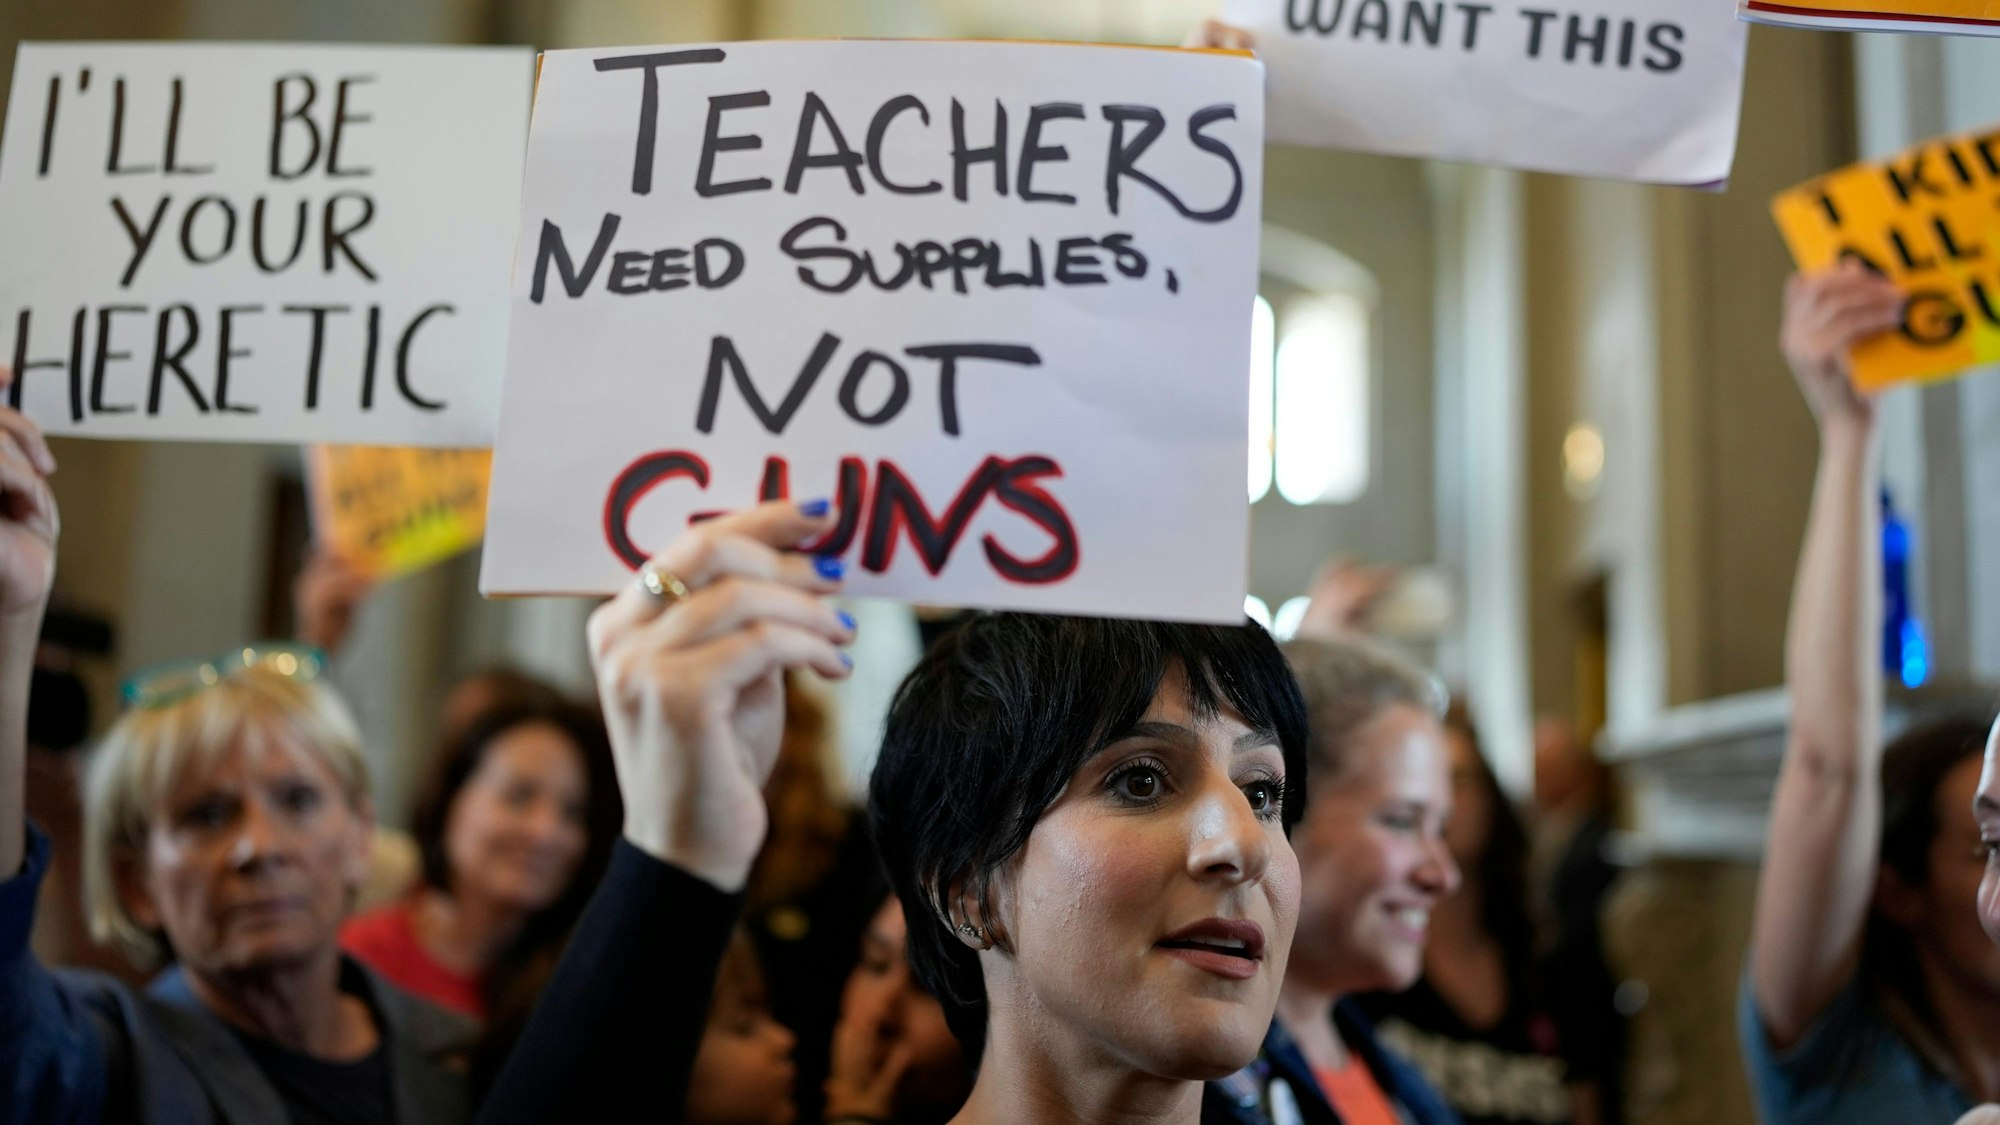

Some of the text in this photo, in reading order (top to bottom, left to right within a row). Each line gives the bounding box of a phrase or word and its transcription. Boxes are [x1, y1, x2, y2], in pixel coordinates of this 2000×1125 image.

[1284, 0, 1686, 74] WANT THIS
[37, 68, 378, 180] I'LL BE
[593, 48, 1244, 224] TEACHERS
[109, 191, 379, 289] YOUR
[530, 213, 1179, 304] NEED SUPPLIES,
[9, 303, 457, 423] HERETIC
[696, 332, 1042, 437] NOT
[603, 450, 1080, 585] GUNS
